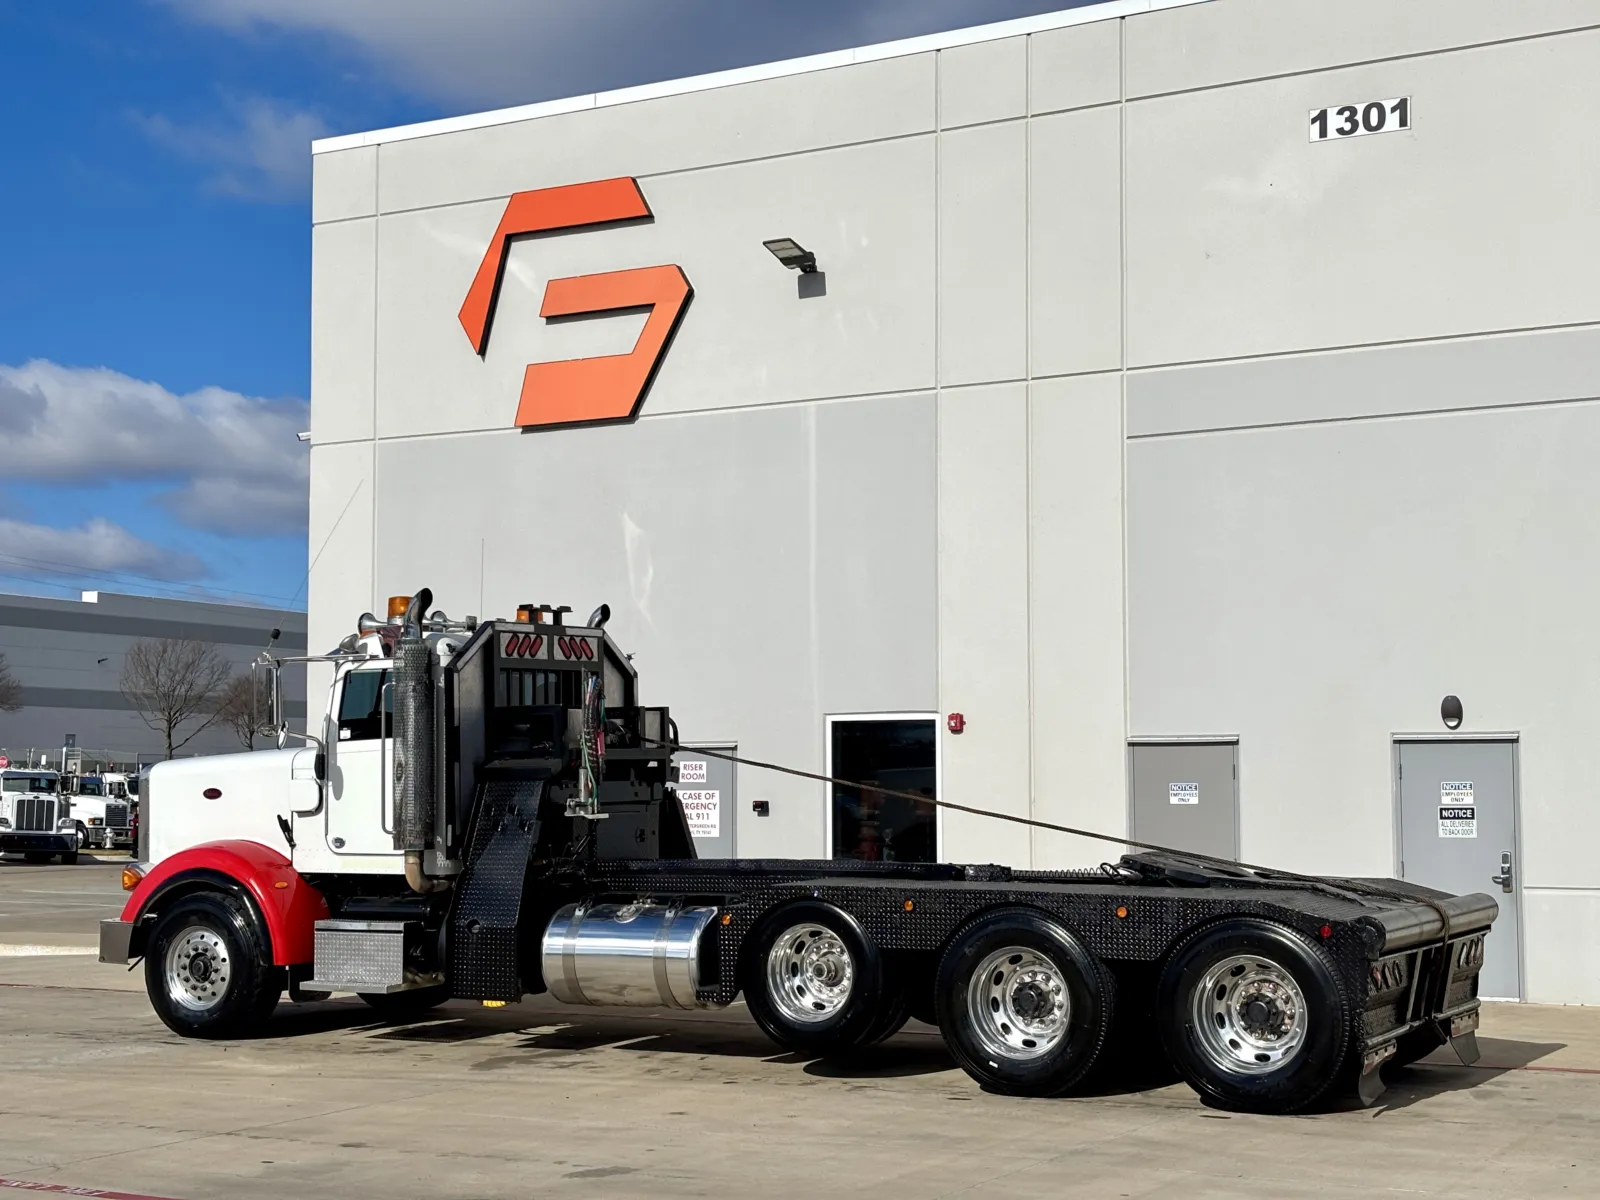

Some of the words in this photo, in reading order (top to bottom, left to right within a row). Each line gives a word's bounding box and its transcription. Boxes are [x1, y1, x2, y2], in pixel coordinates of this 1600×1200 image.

[1310, 97, 1408, 139] 1301
[683, 763, 704, 771] RISER
[681, 772, 706, 780] ROOM
[682, 792, 702, 801] CASE
[704, 792, 716, 801] OF
[685, 812, 694, 820] AL
[695, 812, 710, 820] 911
[1442, 809, 1473, 818] NOTICE
